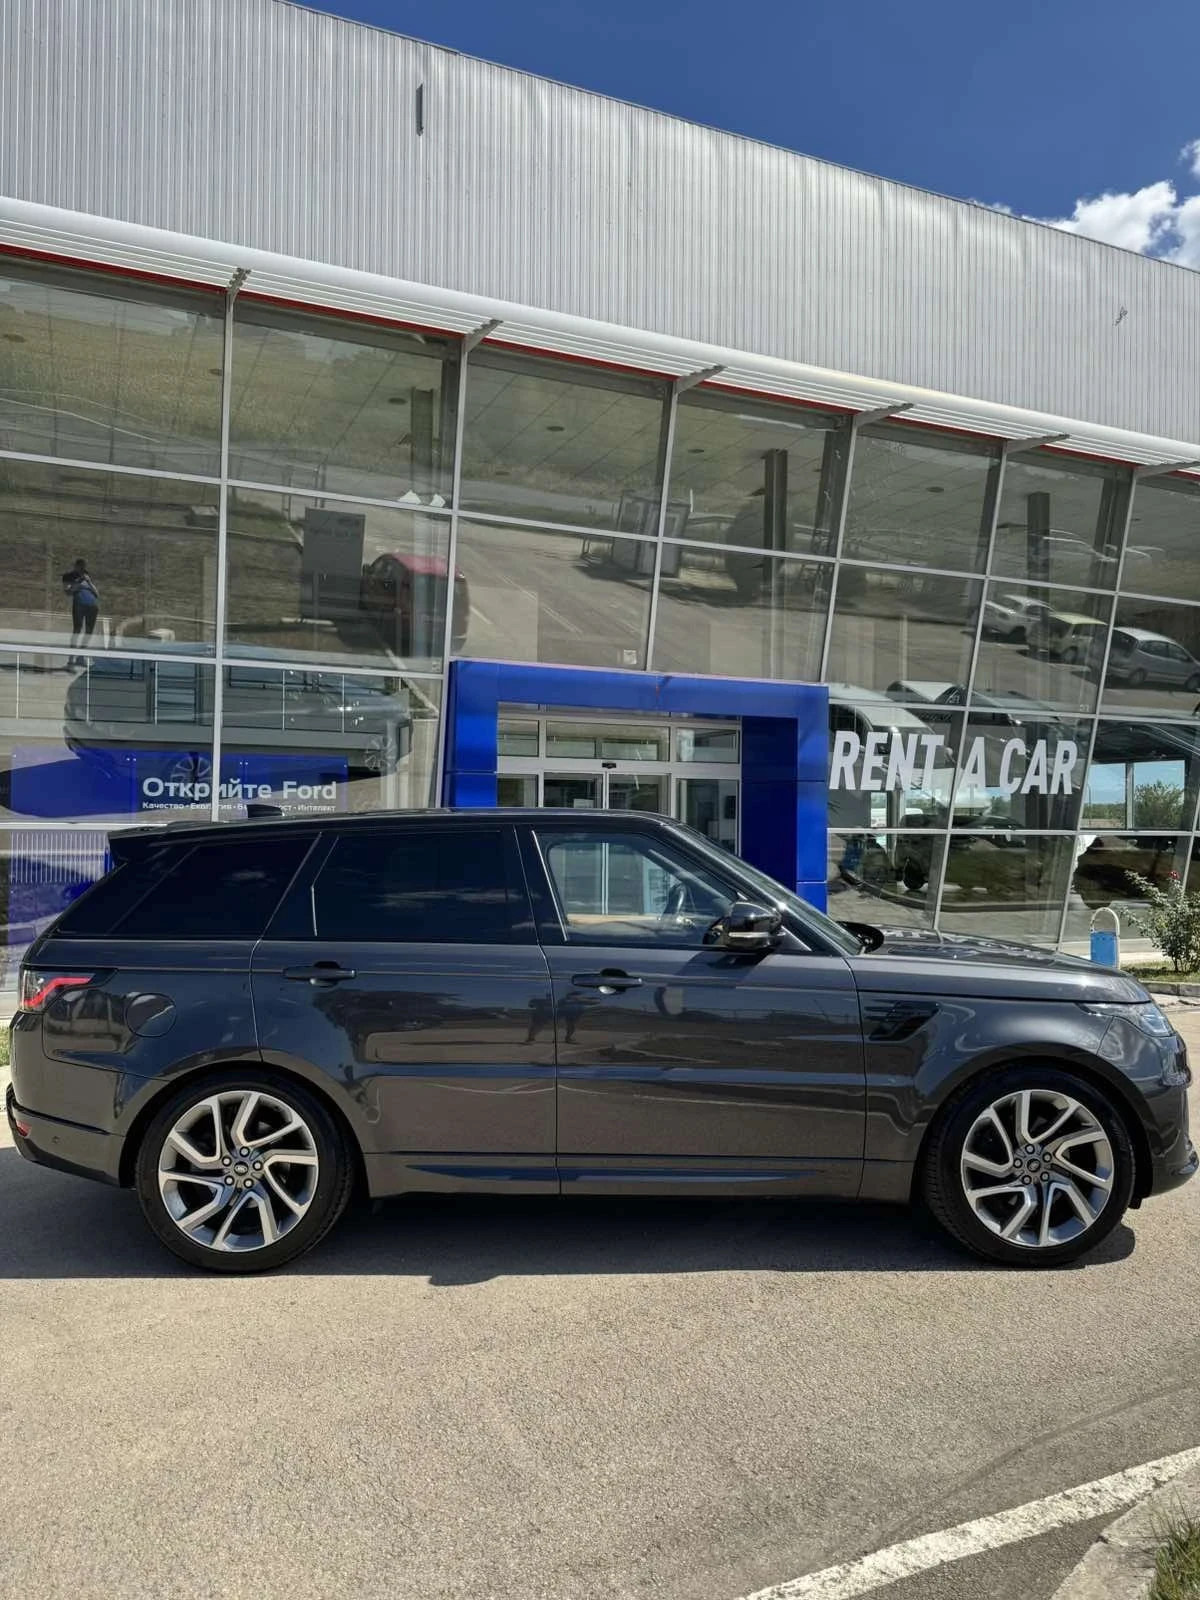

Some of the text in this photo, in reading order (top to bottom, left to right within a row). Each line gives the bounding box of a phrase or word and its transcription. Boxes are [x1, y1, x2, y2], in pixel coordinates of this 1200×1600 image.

[829, 730, 1078, 795] RENT A CAR
[142, 777, 337, 801] Открийте Ford
[142, 801, 185, 810] Качество
